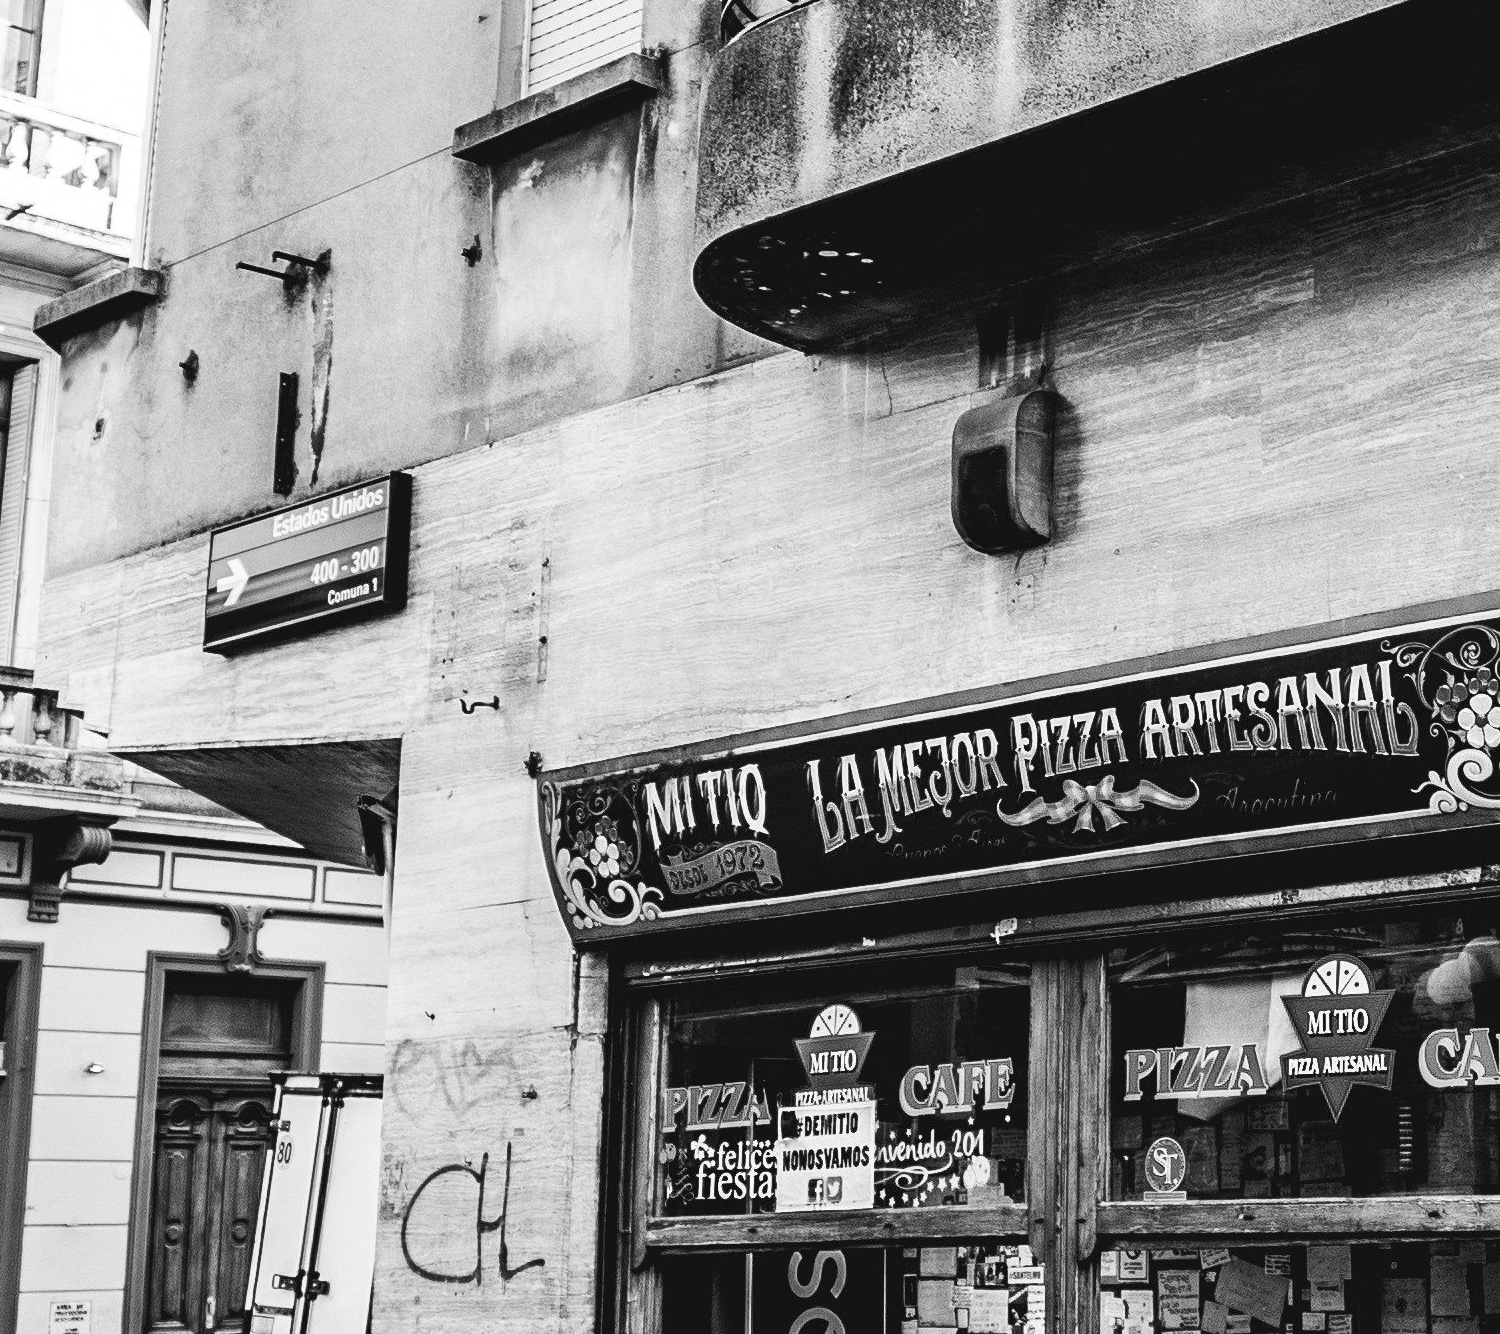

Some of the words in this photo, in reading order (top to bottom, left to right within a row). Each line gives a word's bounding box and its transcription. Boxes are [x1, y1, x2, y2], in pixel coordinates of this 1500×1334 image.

[273, 504, 329, 538] Estados
[331, 487, 384, 519] Unidos
[310, 558, 339, 585] 400
[350, 546, 379, 574] 300
[327, 583, 369, 605] Comuna
[372, 577, 378, 592] 1
[643, 774, 697, 856] MI
[807, 754, 879, 855] LA
[876, 727, 1009, 844] MEJOR
[1009, 707, 1128, 796] PIZZA
[1142, 660, 1420, 759] ARTESANAL
[1307, 1010, 1331, 1035] MI
[1333, 1008, 1369, 1034] TIO
[809, 1051, 828, 1075] MI
[830, 1049, 857, 1073] TIO
[1124, 1043, 1269, 1101] PIZZA
[1288, 1057, 1320, 1076] PIZZA
[1322, 1053, 1388, 1074] ARTESANAL
[900, 1057, 1016, 1117] CAFE
[662, 1081, 772, 1134] PIZZA
[276, 1139, 293, 1165] 80
[716, 1140, 777, 1171] felice
[782, 1145, 870, 1172] NONOSVAMOS
[695, 1159, 777, 1201] fiesta
